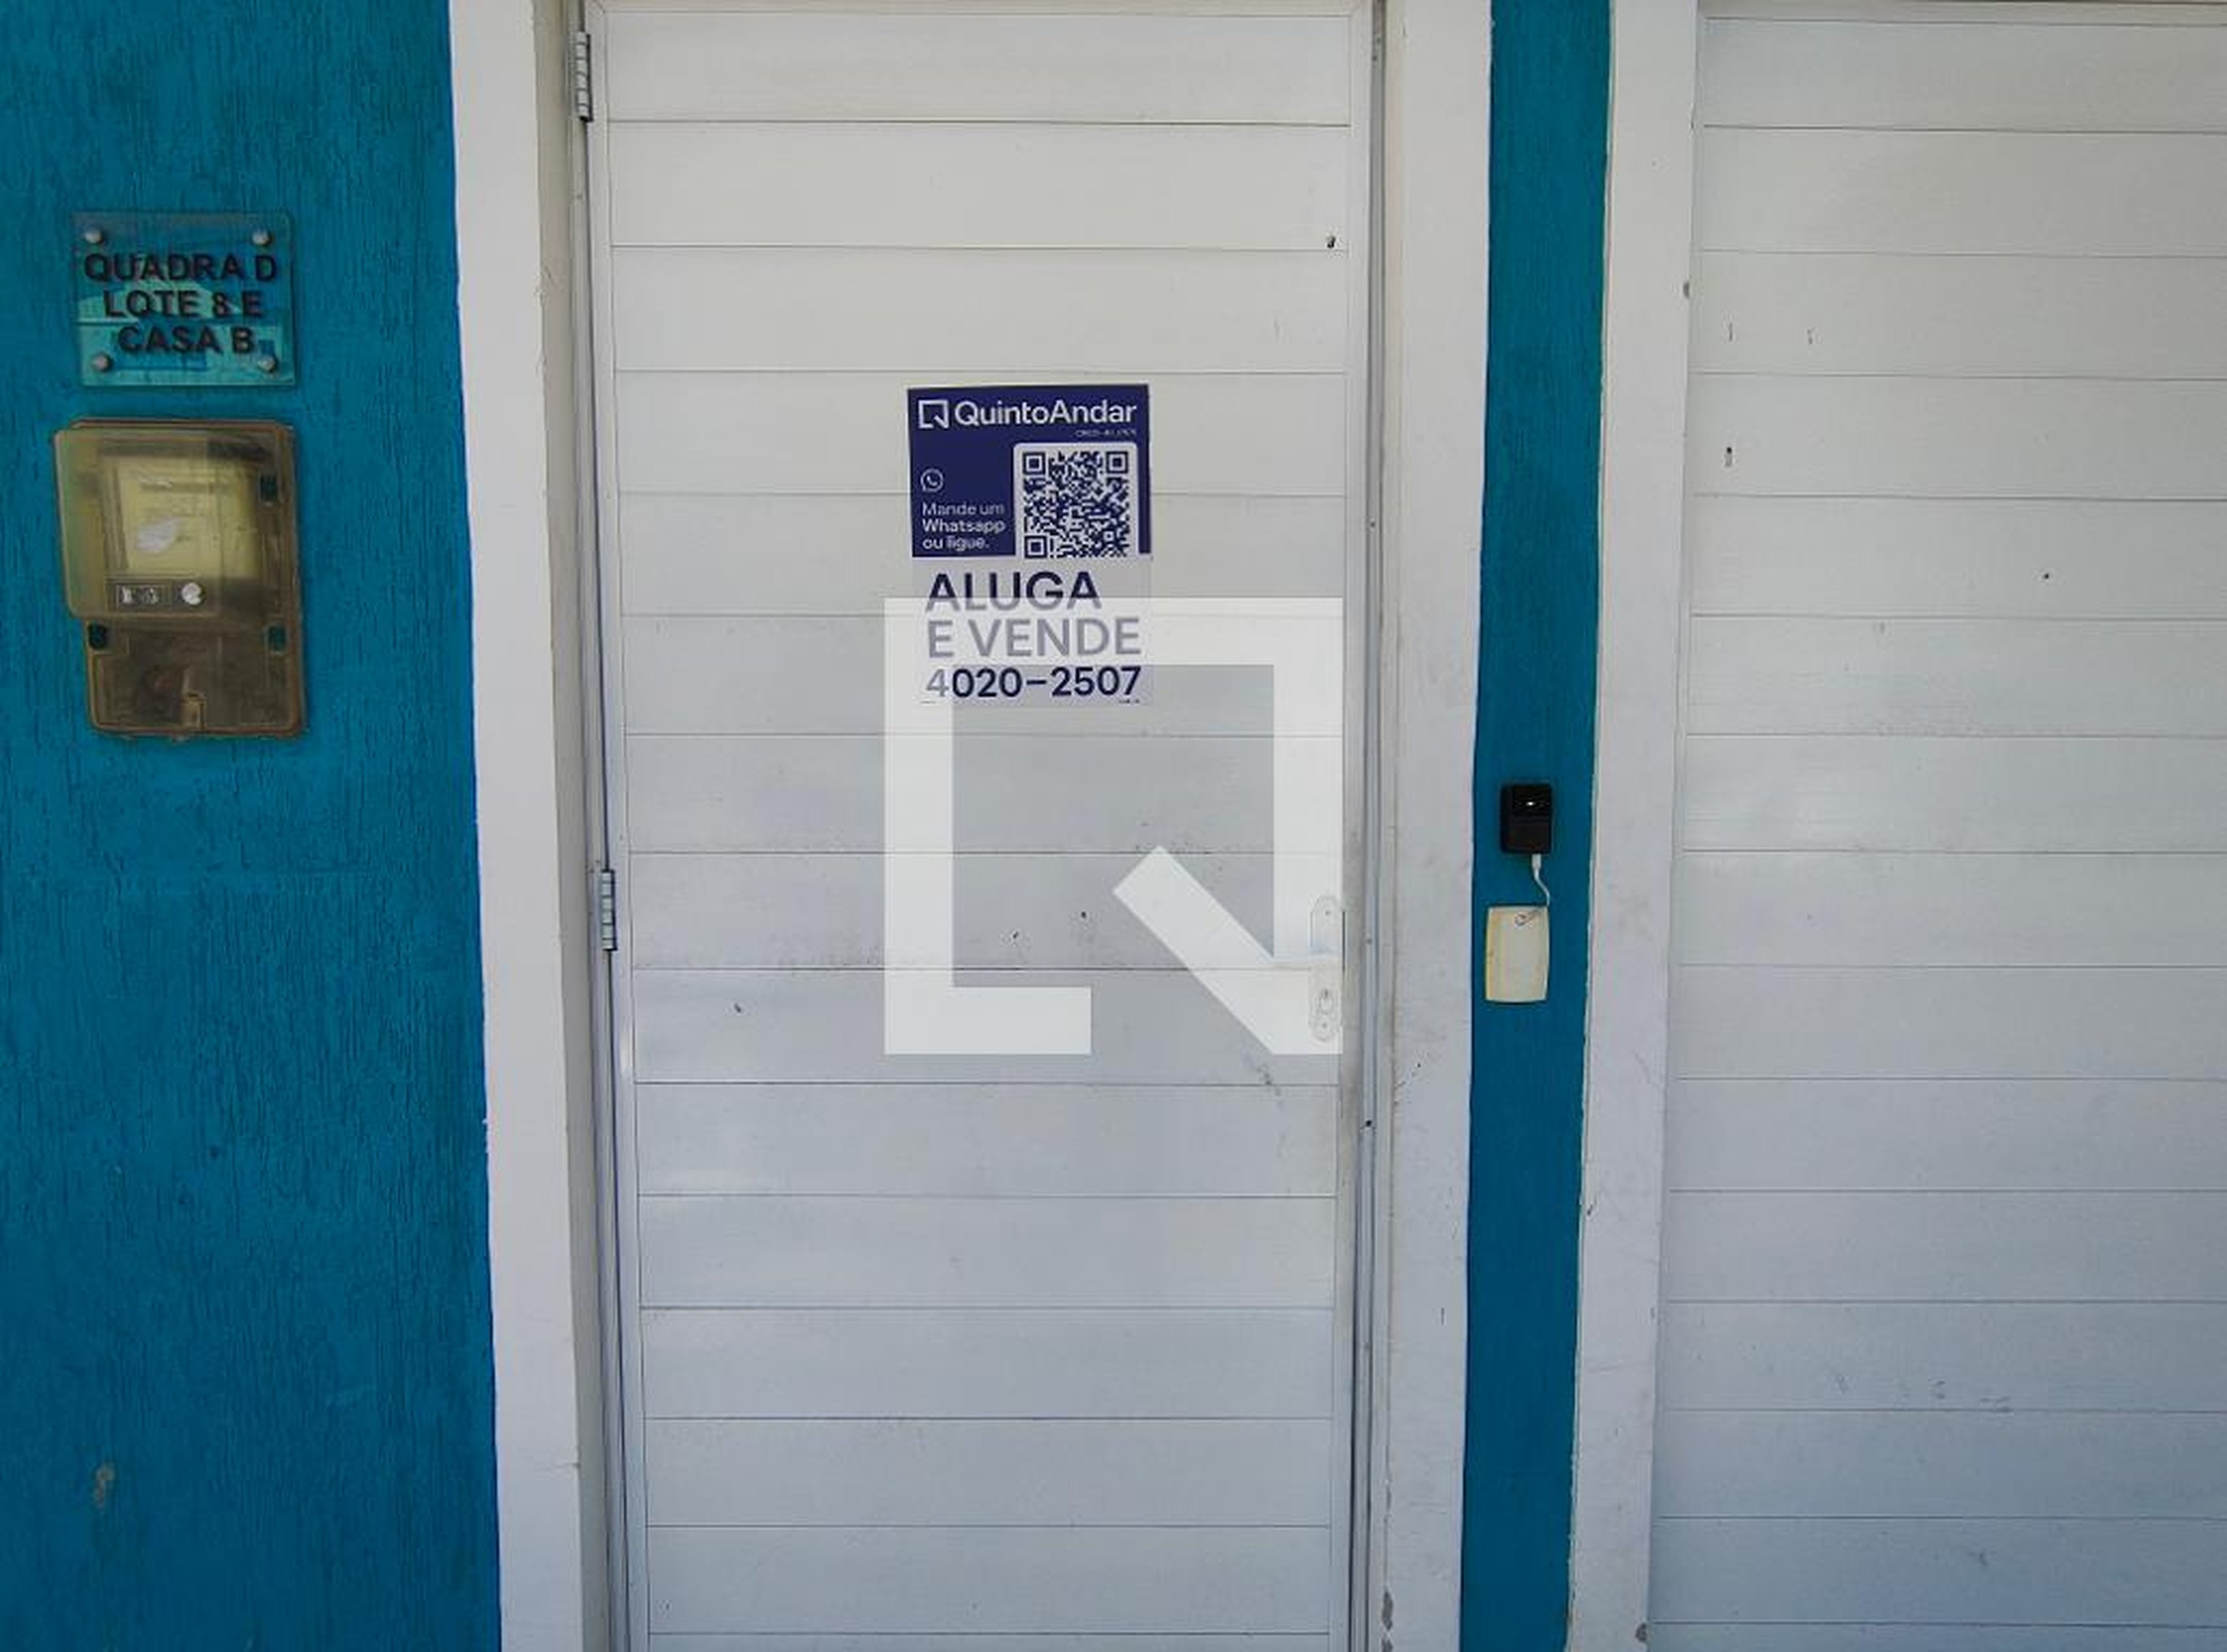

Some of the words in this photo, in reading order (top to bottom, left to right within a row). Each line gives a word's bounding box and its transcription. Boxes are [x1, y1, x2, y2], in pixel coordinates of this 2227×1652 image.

[84, 253, 246, 282] QUADRA
[254, 255, 278, 282] D
[104, 289, 202, 318] LOTE
[241, 290, 264, 318] E
[118, 325, 224, 356] CASA
[230, 327, 255, 354] B
[955, 399, 1137, 426] QuintoAndar
[922, 501, 977, 515] Mande
[979, 503, 1005, 515] um
[922, 518, 1006, 534] Whatsapp
[922, 539, 944, 549] ou
[926, 571, 1102, 612] ALUGA
[928, 620, 953, 658] E
[967, 617, 1141, 657] VENDE
[926, 665, 1141, 698] 4020-2507
